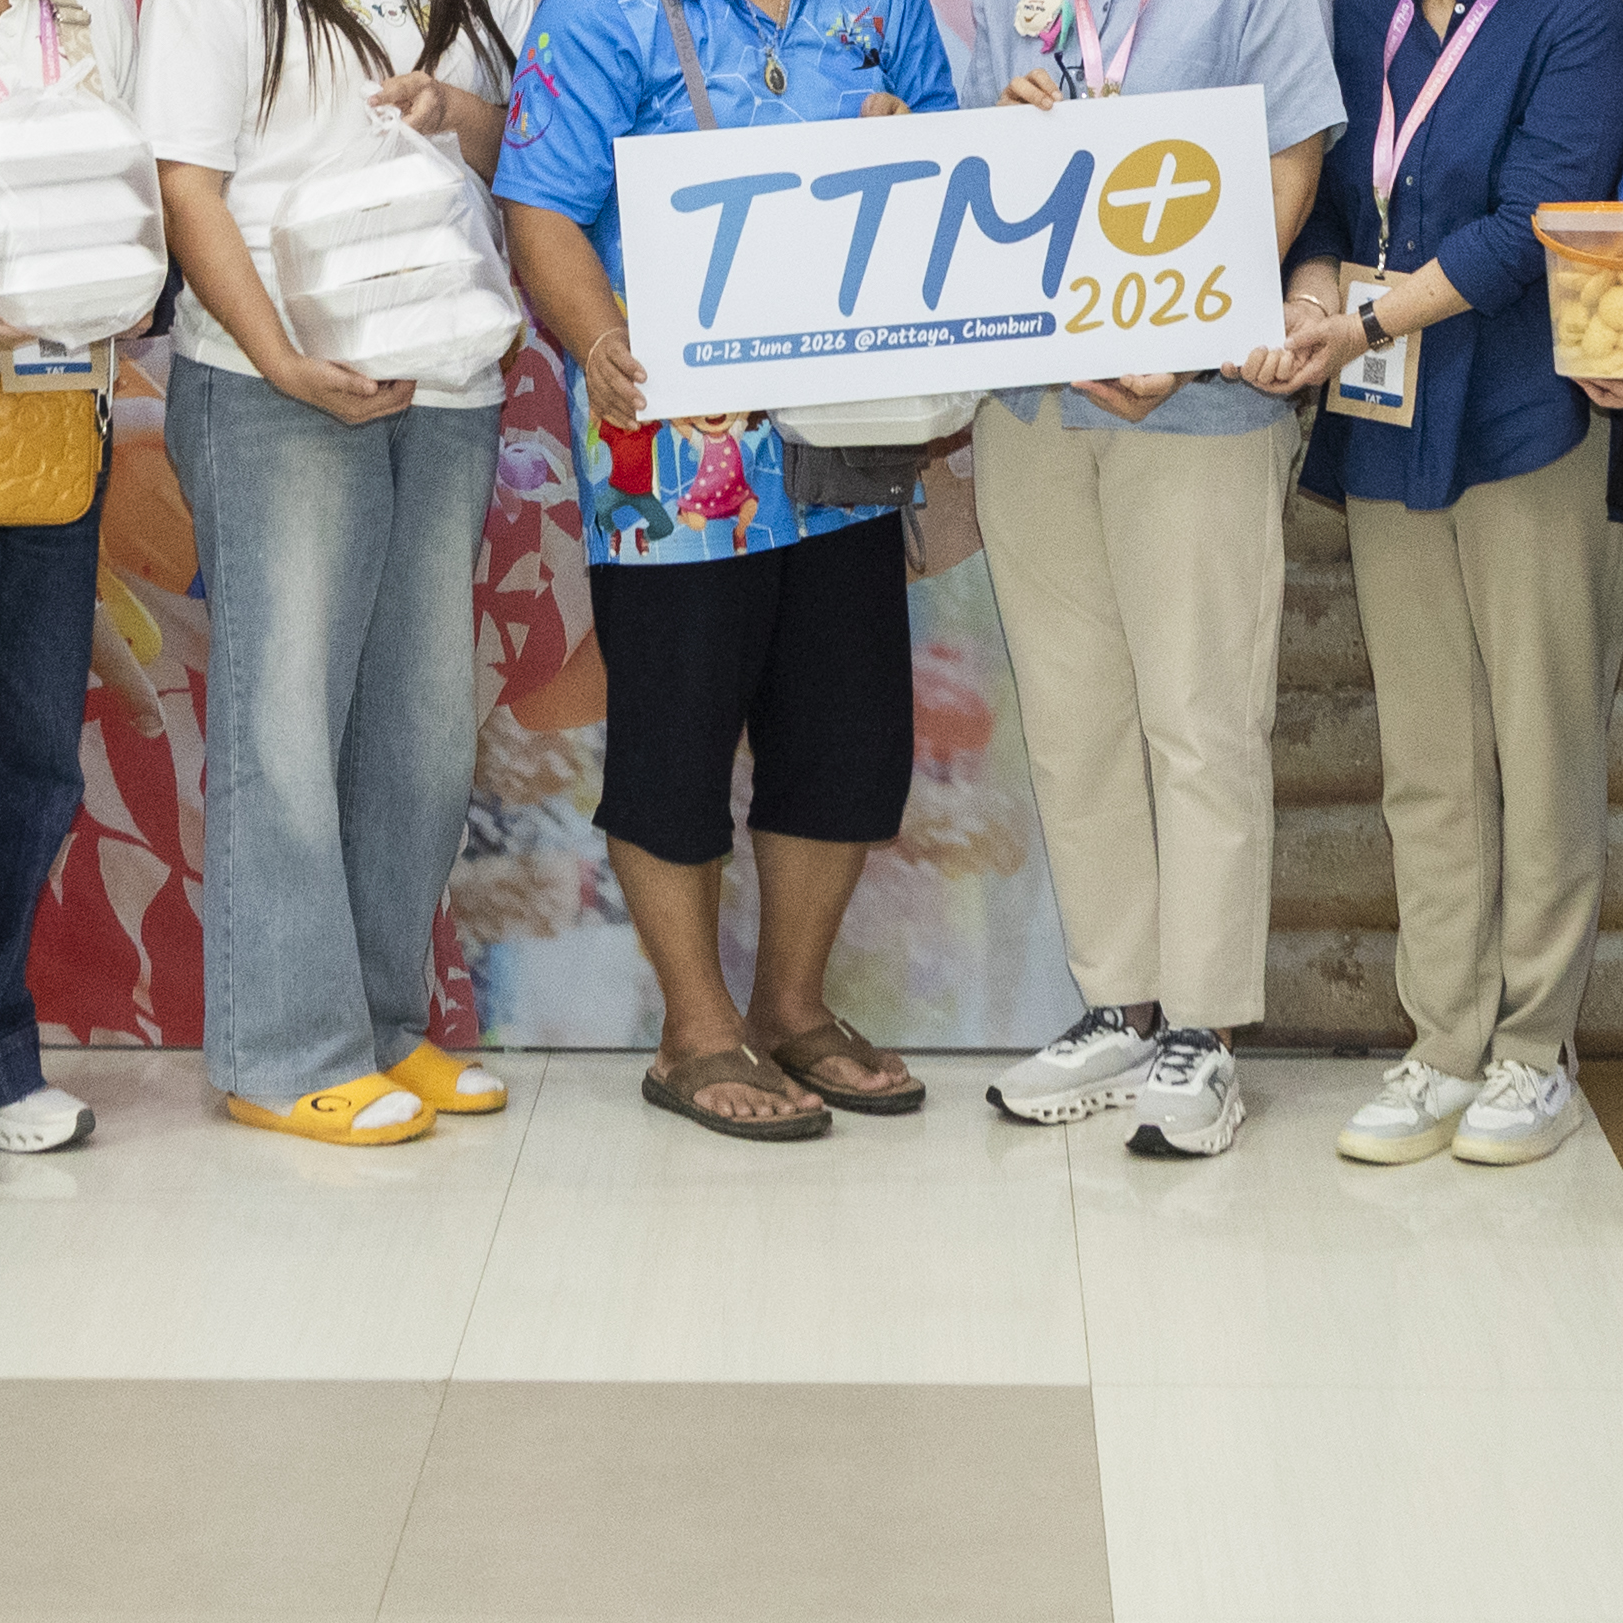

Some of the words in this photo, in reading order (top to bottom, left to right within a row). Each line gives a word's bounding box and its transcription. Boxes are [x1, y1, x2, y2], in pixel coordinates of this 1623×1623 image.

[1439, 34, 1466, 73] THAILAND
[1065, 265, 1232, 334] 2026
[695, 341, 742, 363] 10-12
[750, 339, 792, 357] June
[800, 332, 847, 353] 2026
[853, 327, 956, 352] @Pattaya,
[962, 315, 1044, 339] Chonburi
[1364, 392, 1383, 406] TAT
